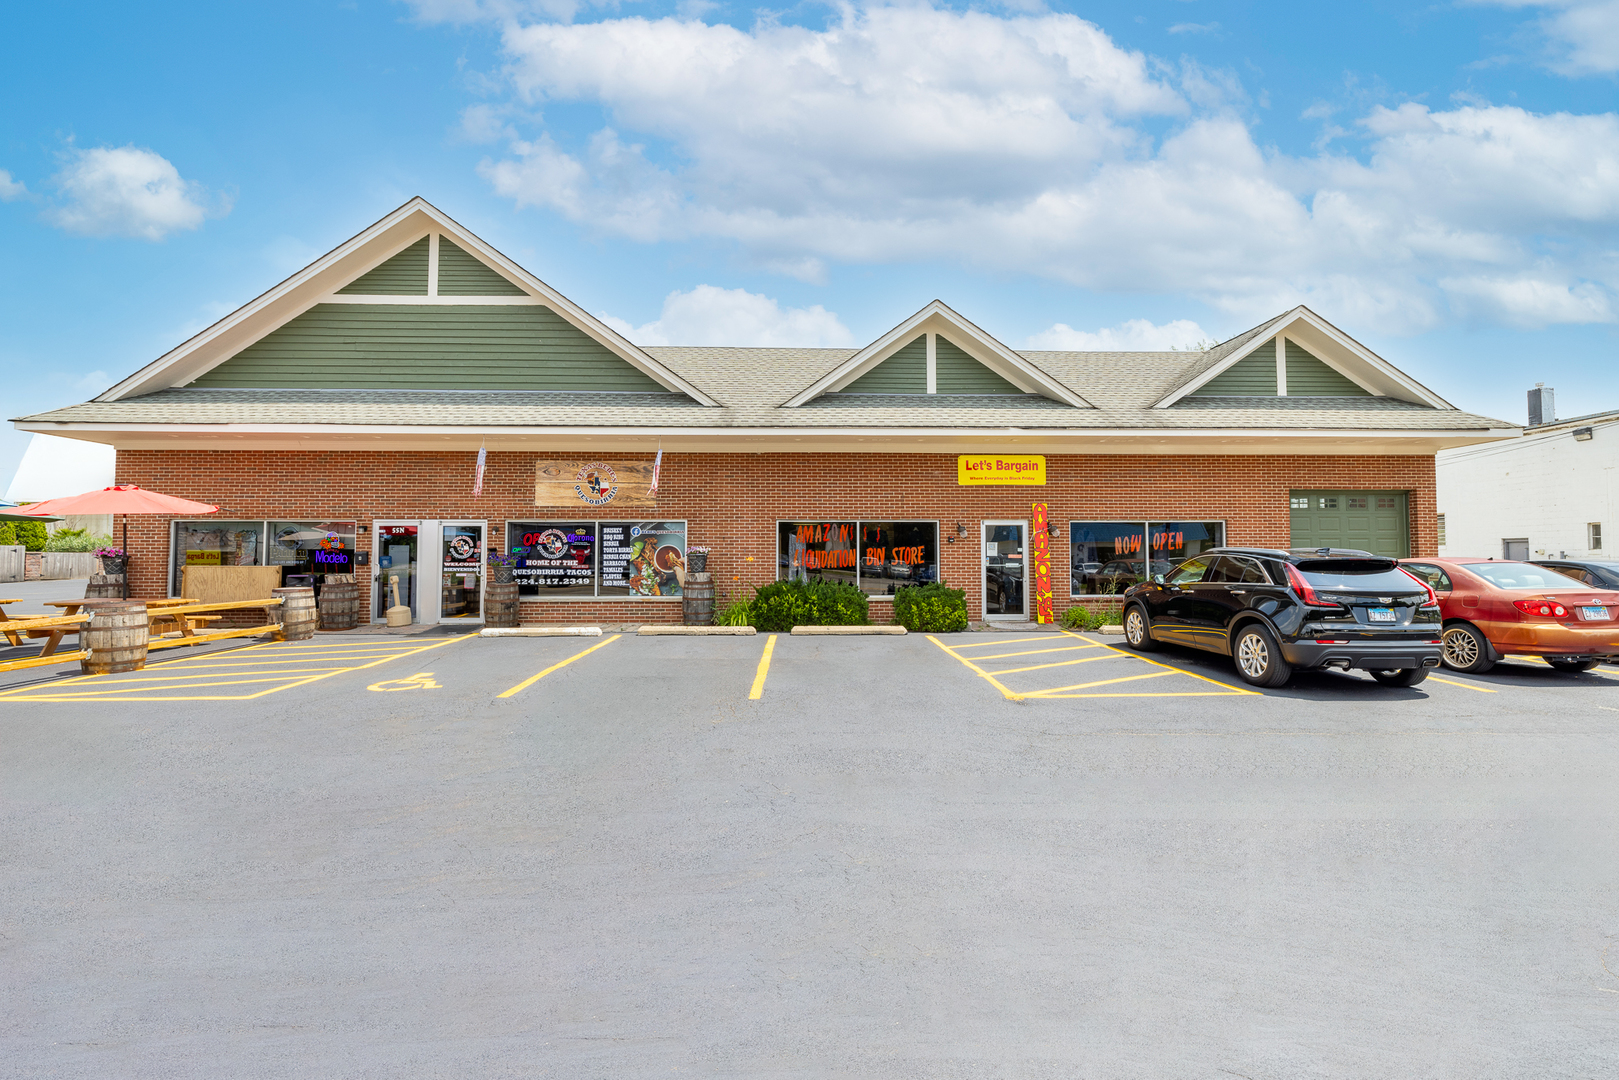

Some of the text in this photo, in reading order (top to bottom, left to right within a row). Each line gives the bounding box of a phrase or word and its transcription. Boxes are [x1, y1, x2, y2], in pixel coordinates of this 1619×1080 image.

[576, 462, 596, 480] TEXAS
[965, 460, 1039, 473] Let's Bargain
[567, 533, 595, 544] Corona
[796, 523, 849, 543] AMAZON
[1114, 531, 1183, 555] NOW OPEN
[315, 550, 348, 564] Modelo
[793, 545, 925, 570] LIQUIDATION BIN STORE
[512, 568, 592, 576] QUESOBIRRIA TACOS
